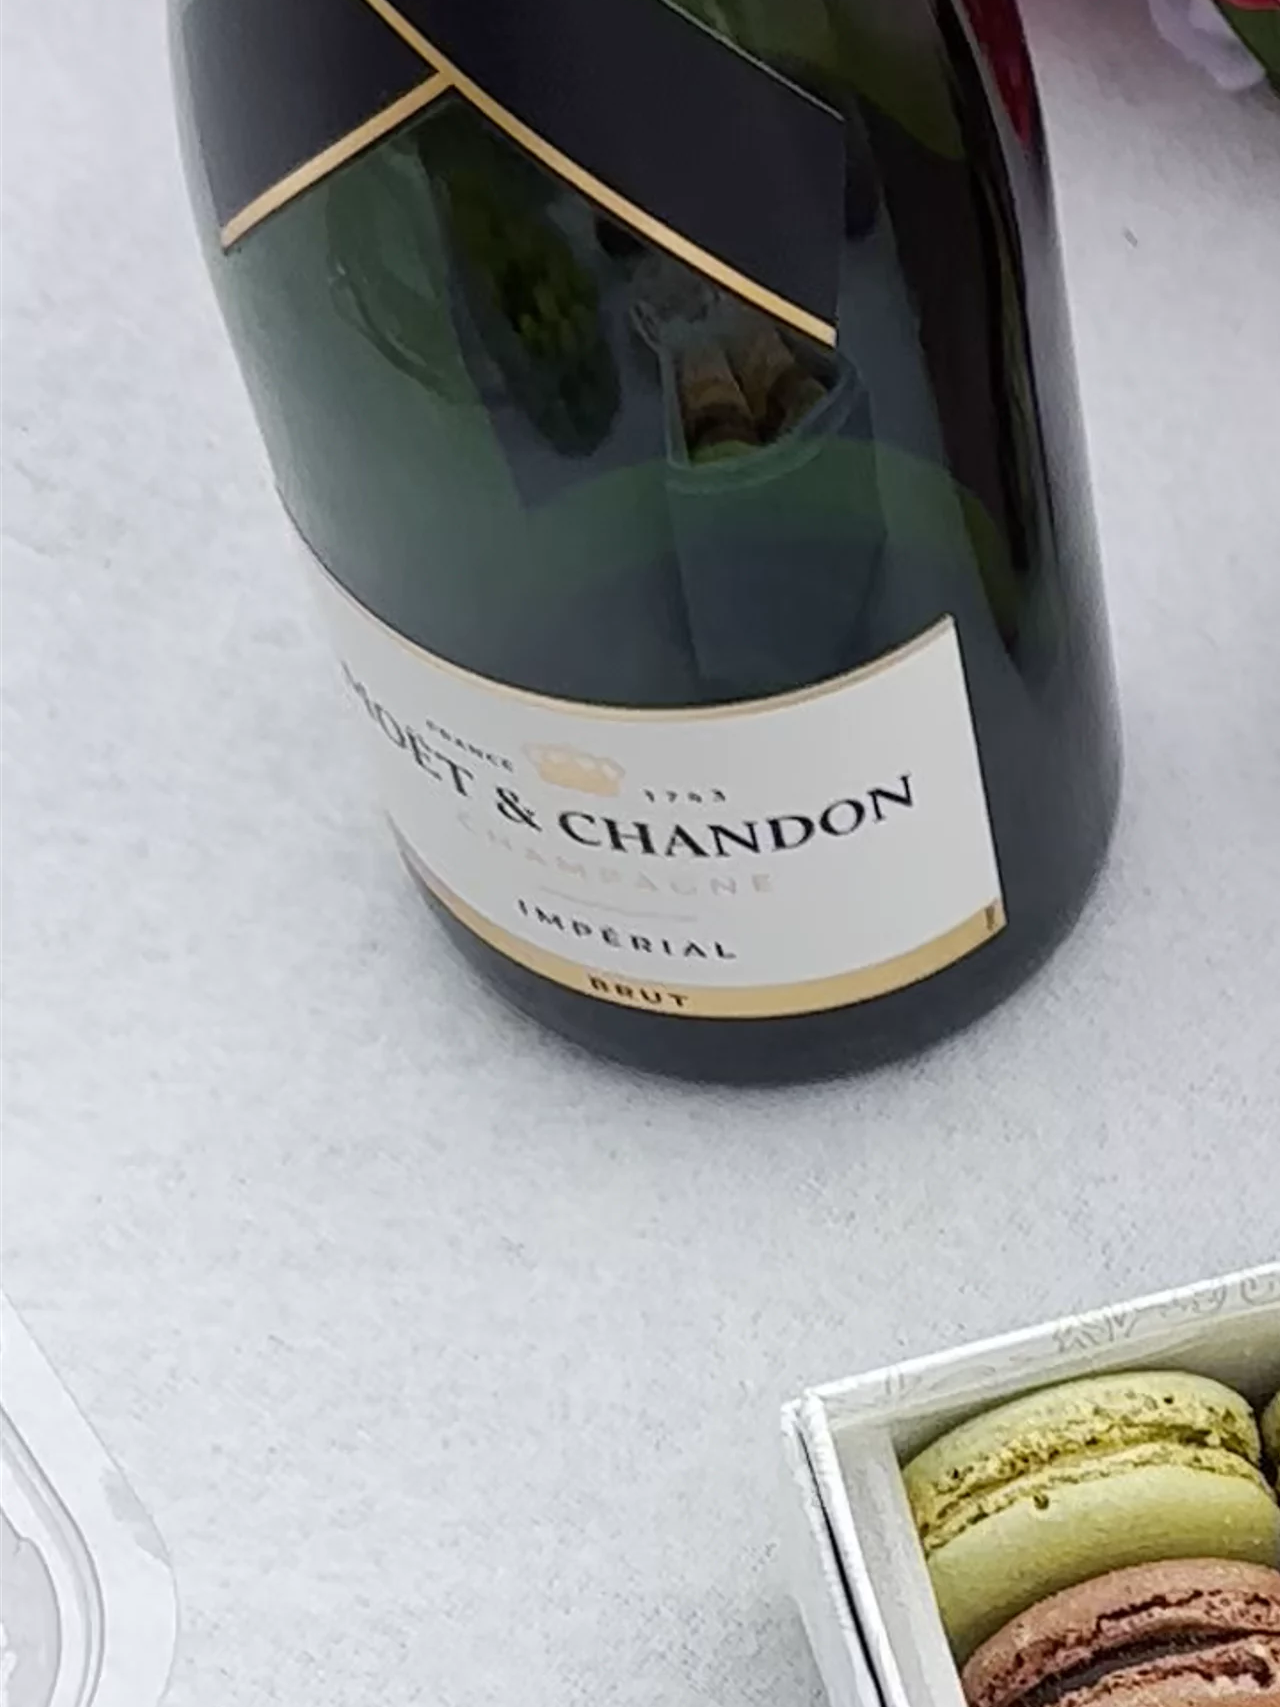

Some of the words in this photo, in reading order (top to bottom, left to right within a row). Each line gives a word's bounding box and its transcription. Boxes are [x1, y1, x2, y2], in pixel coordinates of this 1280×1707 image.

[496, 786, 542, 832] &
[558, 774, 914, 858] CHANDON
[517, 897, 737, 960] IMPÉRIAL
[589, 973, 690, 1008] BRUT
